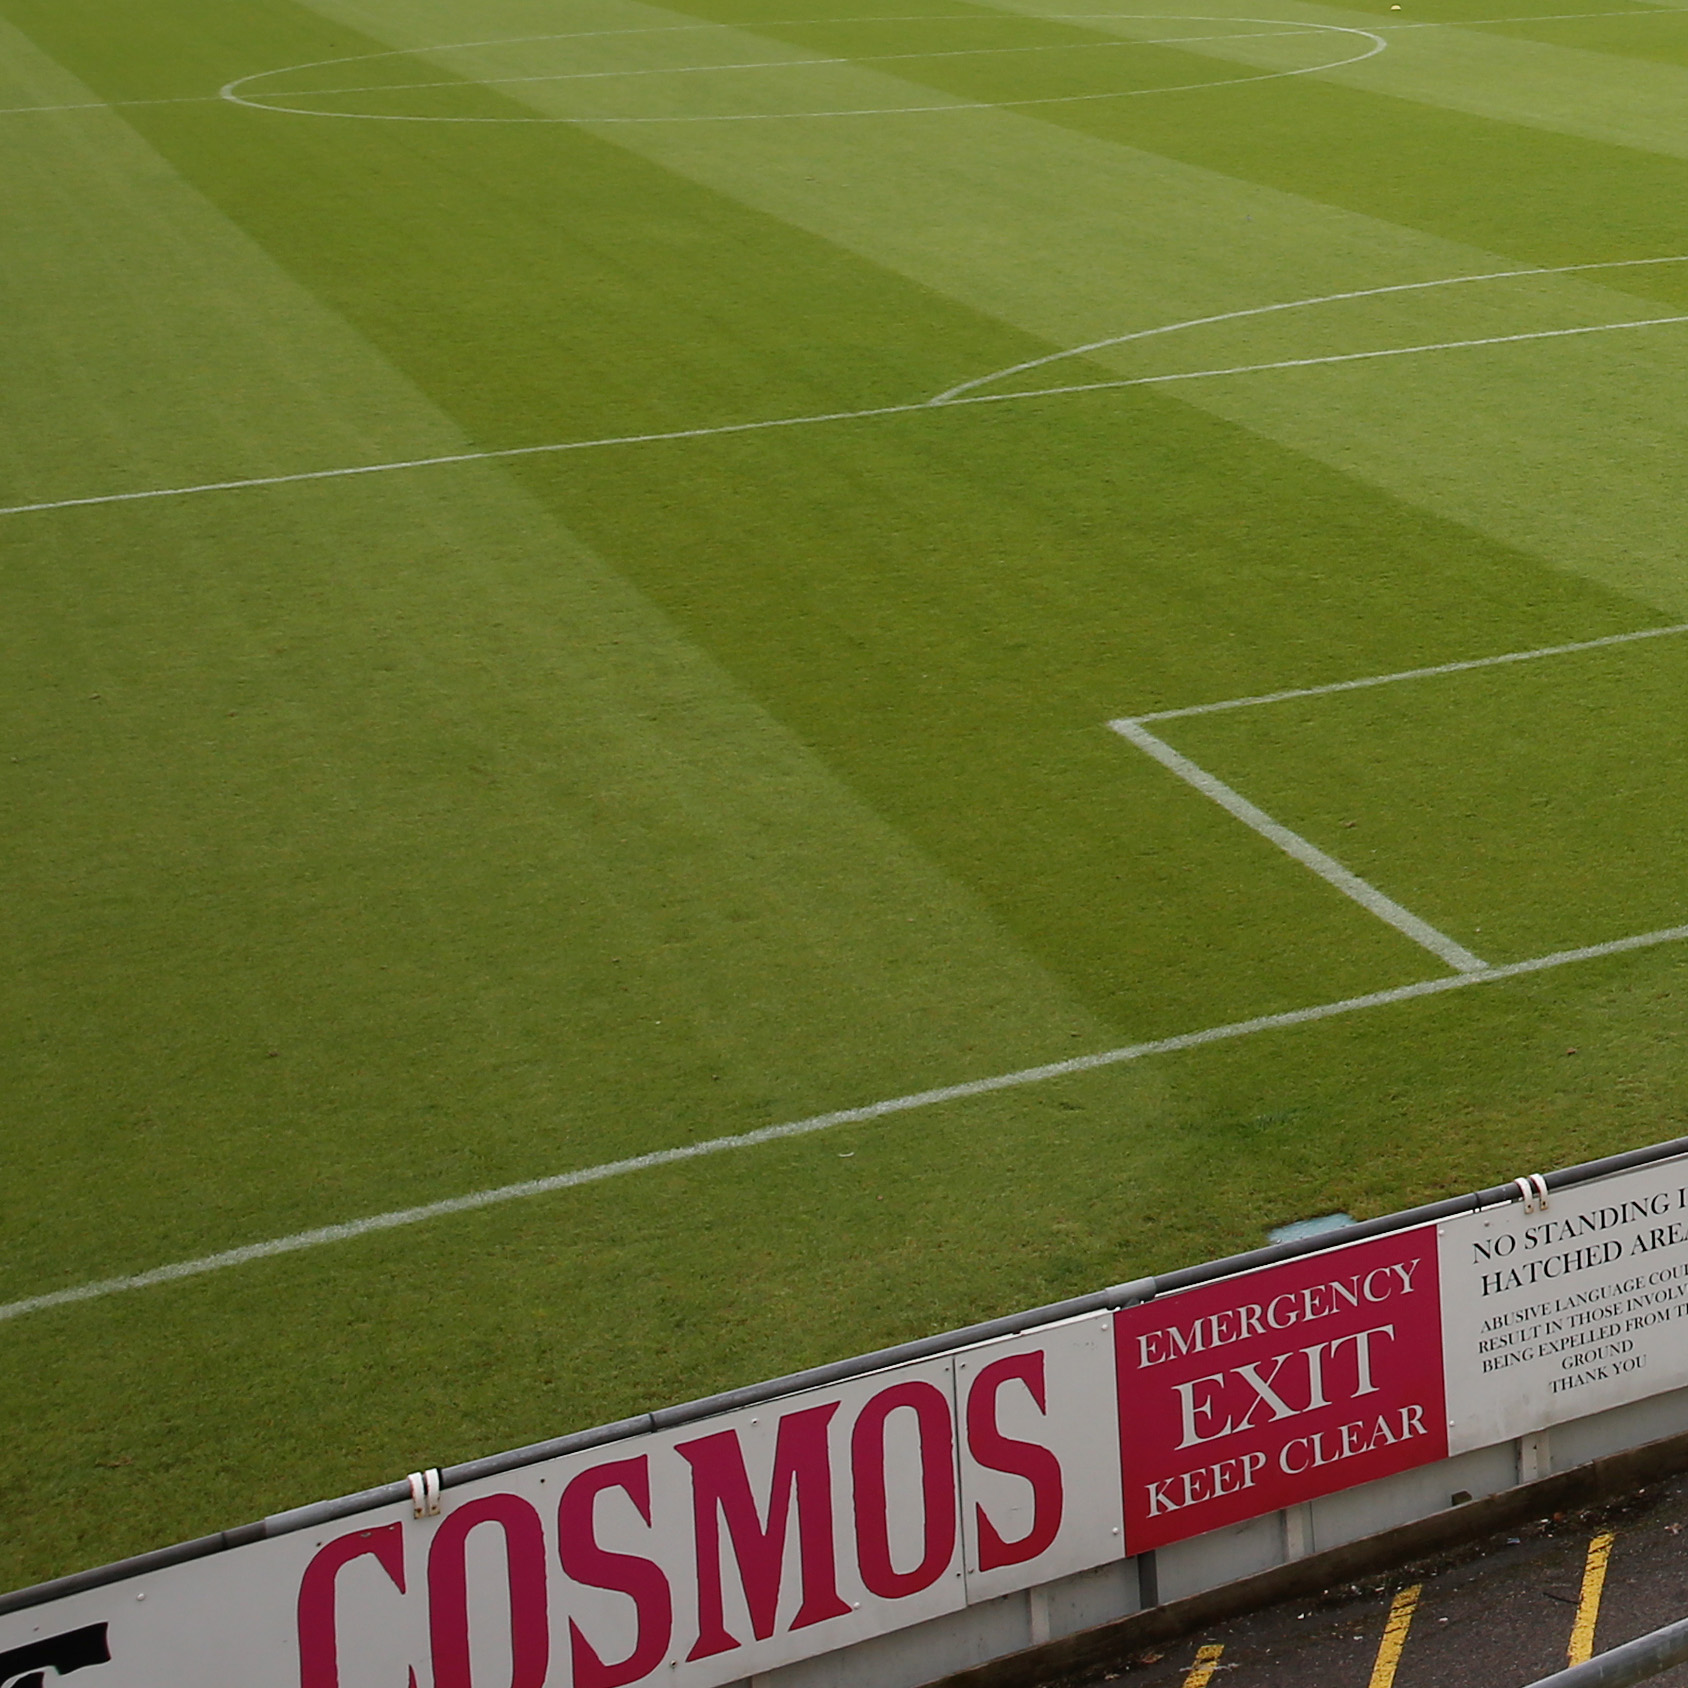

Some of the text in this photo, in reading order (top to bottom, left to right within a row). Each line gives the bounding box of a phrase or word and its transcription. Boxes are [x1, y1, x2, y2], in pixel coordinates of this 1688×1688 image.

[1471, 1232, 1516, 1265] NO
[1525, 1192, 1670, 1251] STANDING
[1481, 1239, 1622, 1297] HATCHED
[1136, 1258, 1421, 1369] EMERGENCY
[1478, 1325, 1540, 1354] RESULT
[1545, 1319, 1563, 1335] IN
[1567, 1303, 1623, 1329] THOSE
[1480, 1302, 1551, 1334] ABUSIVE
[1554, 1276, 1645, 1313] LANGUAGE
[1482, 1347, 1534, 1373] BEING
[1538, 1321, 1621, 1358] EXPELLED
[1625, 1311, 1671, 1338] FROM
[1561, 1339, 1634, 1371] GROUND
[1170, 1324, 1395, 1451] EXIT
[1548, 1355, 1647, 1394] THANK YOU
[1144, 1403, 1428, 1518] KEEP CLEAR
[296, 1350, 1064, 1688] COSMOS
